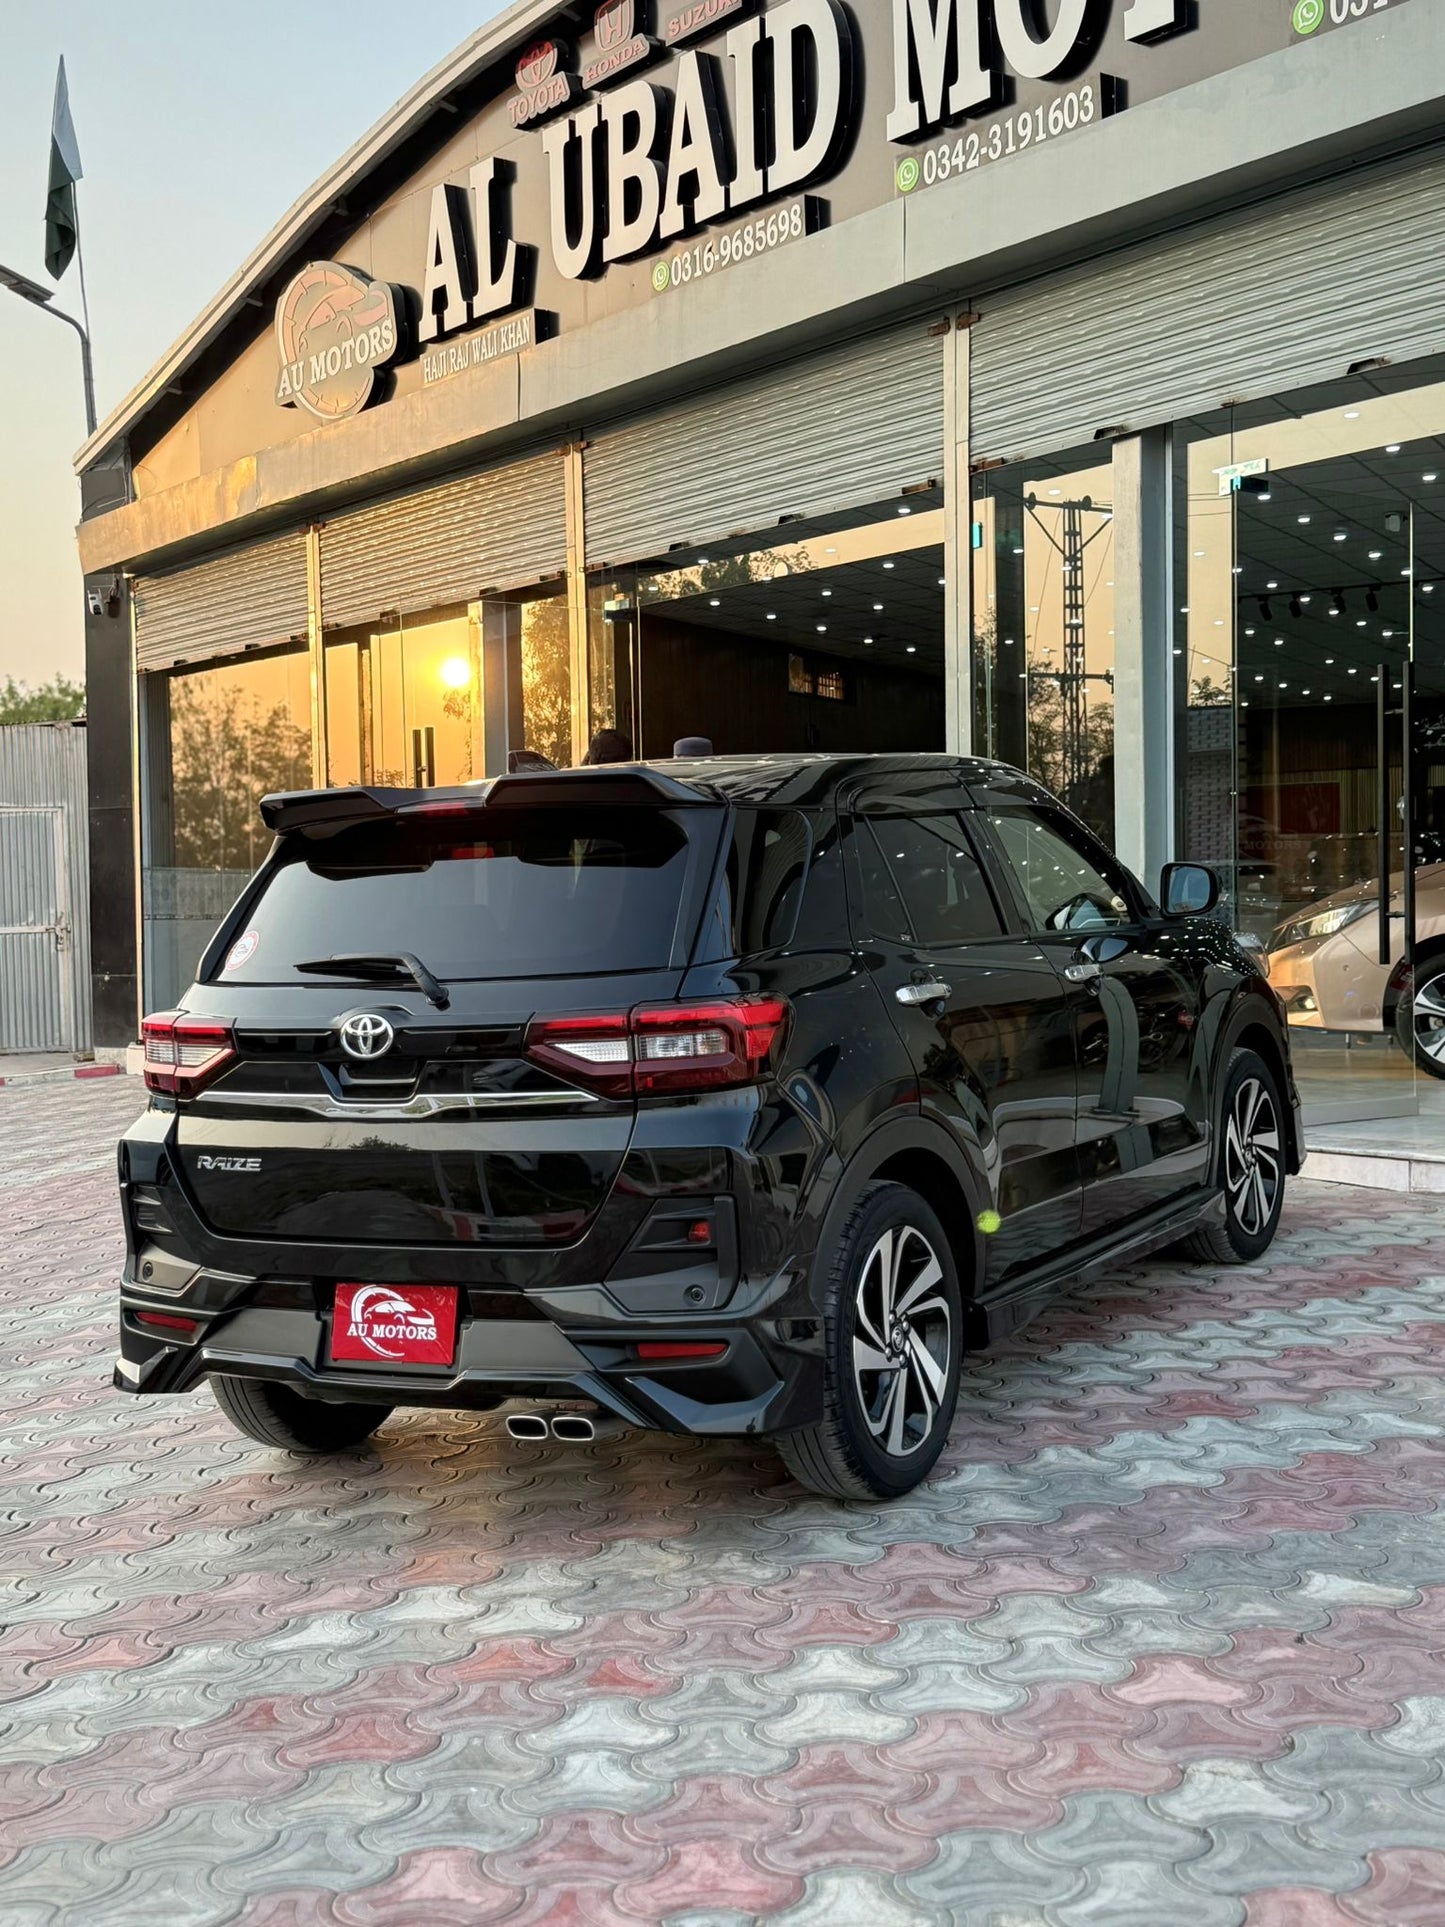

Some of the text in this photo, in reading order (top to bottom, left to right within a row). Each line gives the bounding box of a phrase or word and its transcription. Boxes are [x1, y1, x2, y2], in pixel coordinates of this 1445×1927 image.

[667, 0, 740, 37] SUZU
[586, 39, 646, 81] HONDA
[508, 77, 567, 126] TOYOTA
[923, 85, 1095, 185] 0342-3191603
[418, 156, 516, 343] AL
[542, 0, 841, 279] UBAID
[670, 203, 802, 286] 0316-9685698
[277, 319, 394, 398] AU MOTORS
[423, 316, 530, 384] HAJI RAJ WALI KHAN
[197, 1155, 262, 1172] RAIZE
[346, 1323, 437, 1341] AU MOTORS
